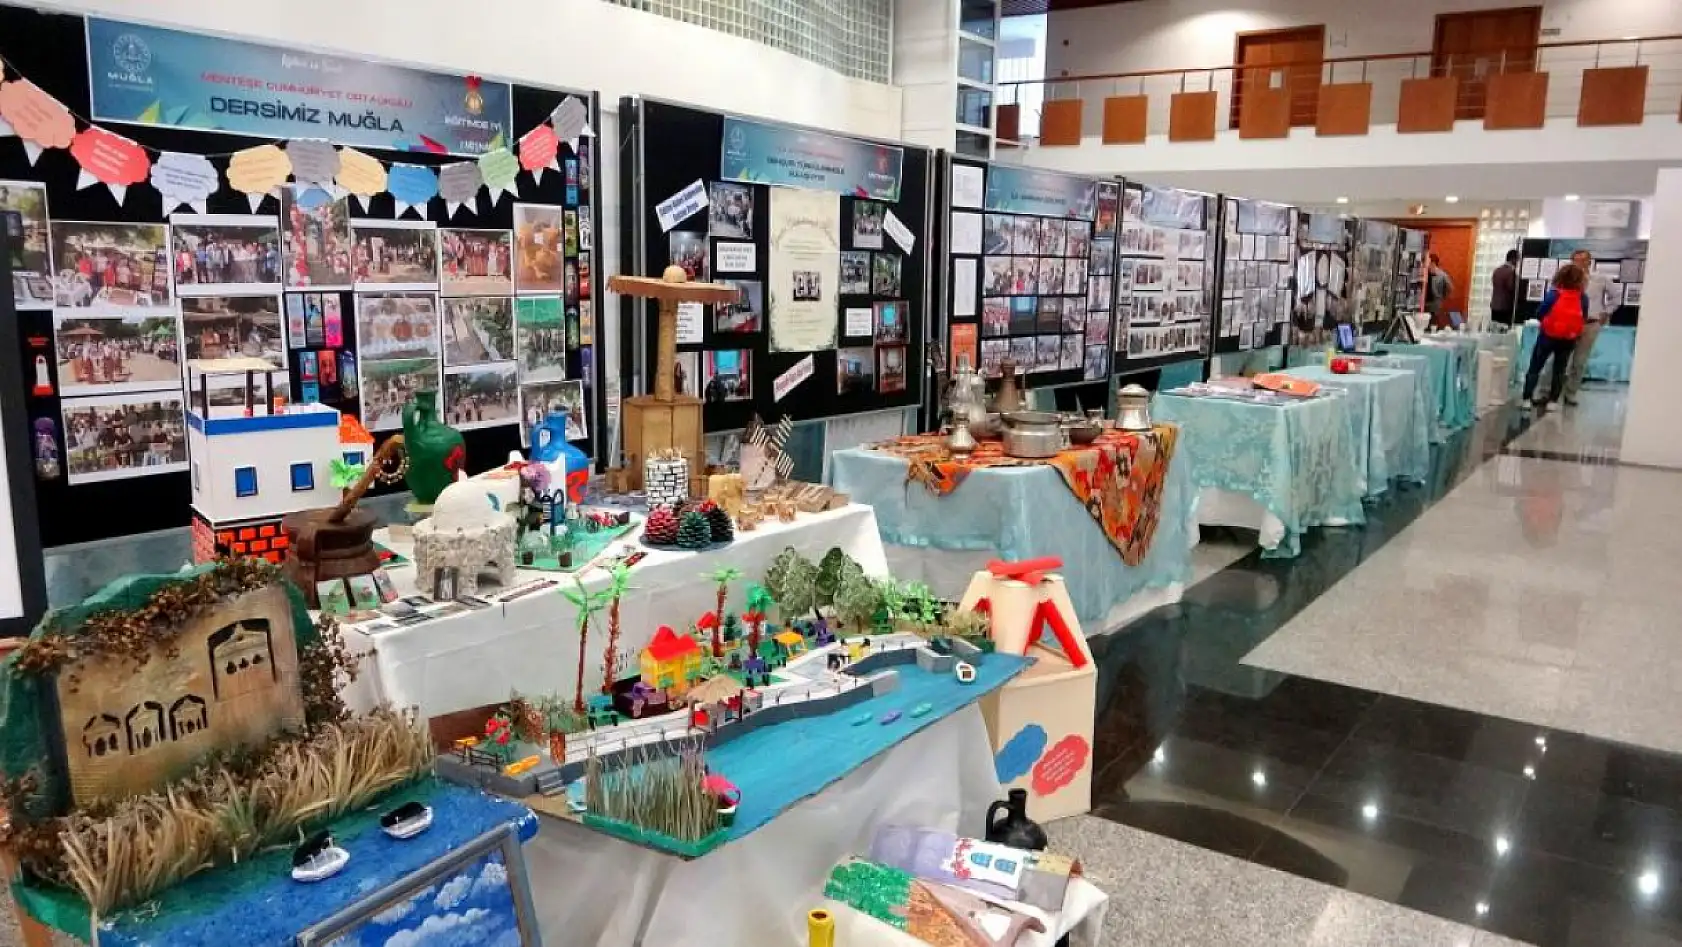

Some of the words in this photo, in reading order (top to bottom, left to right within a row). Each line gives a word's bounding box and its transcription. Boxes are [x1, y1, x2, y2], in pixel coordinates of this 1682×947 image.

[107, 71, 153, 84] MUĞLA
[211, 97, 321, 124] DERSİMİZ
[328, 109, 404, 132] MUĞLA
